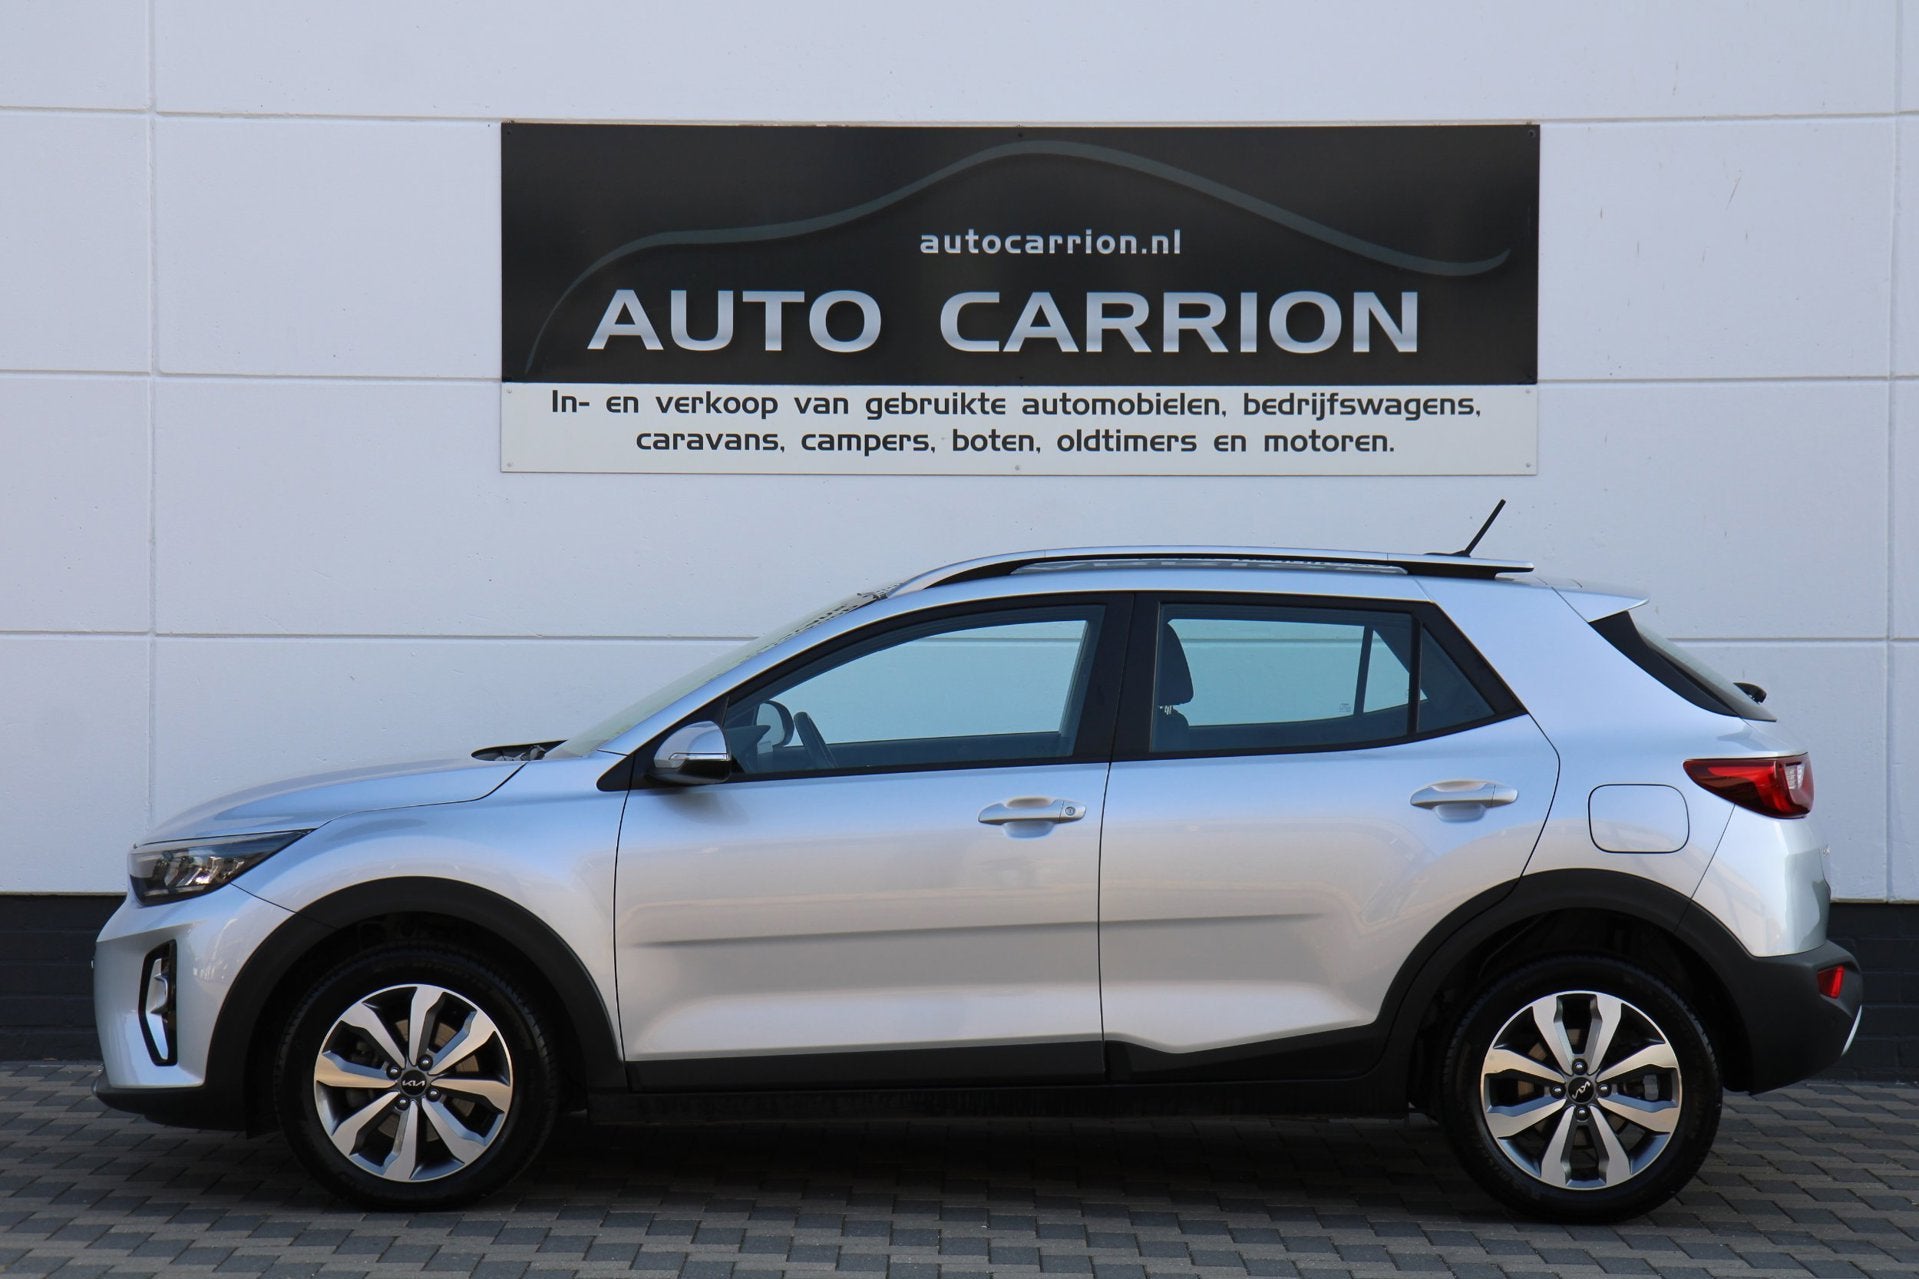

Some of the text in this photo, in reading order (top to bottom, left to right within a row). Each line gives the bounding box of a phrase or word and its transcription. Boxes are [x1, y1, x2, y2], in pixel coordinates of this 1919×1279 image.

[920, 228, 1181, 255] autocarrion.nl
[587, 289, 1418, 354] AUTO CARRION
[552, 389, 1482, 422] In- en verkoop van gebruikte automobielen, bedrijfswagens,
[637, 429, 1395, 457] caravans, campers, boten, oldtimers en motoren.
